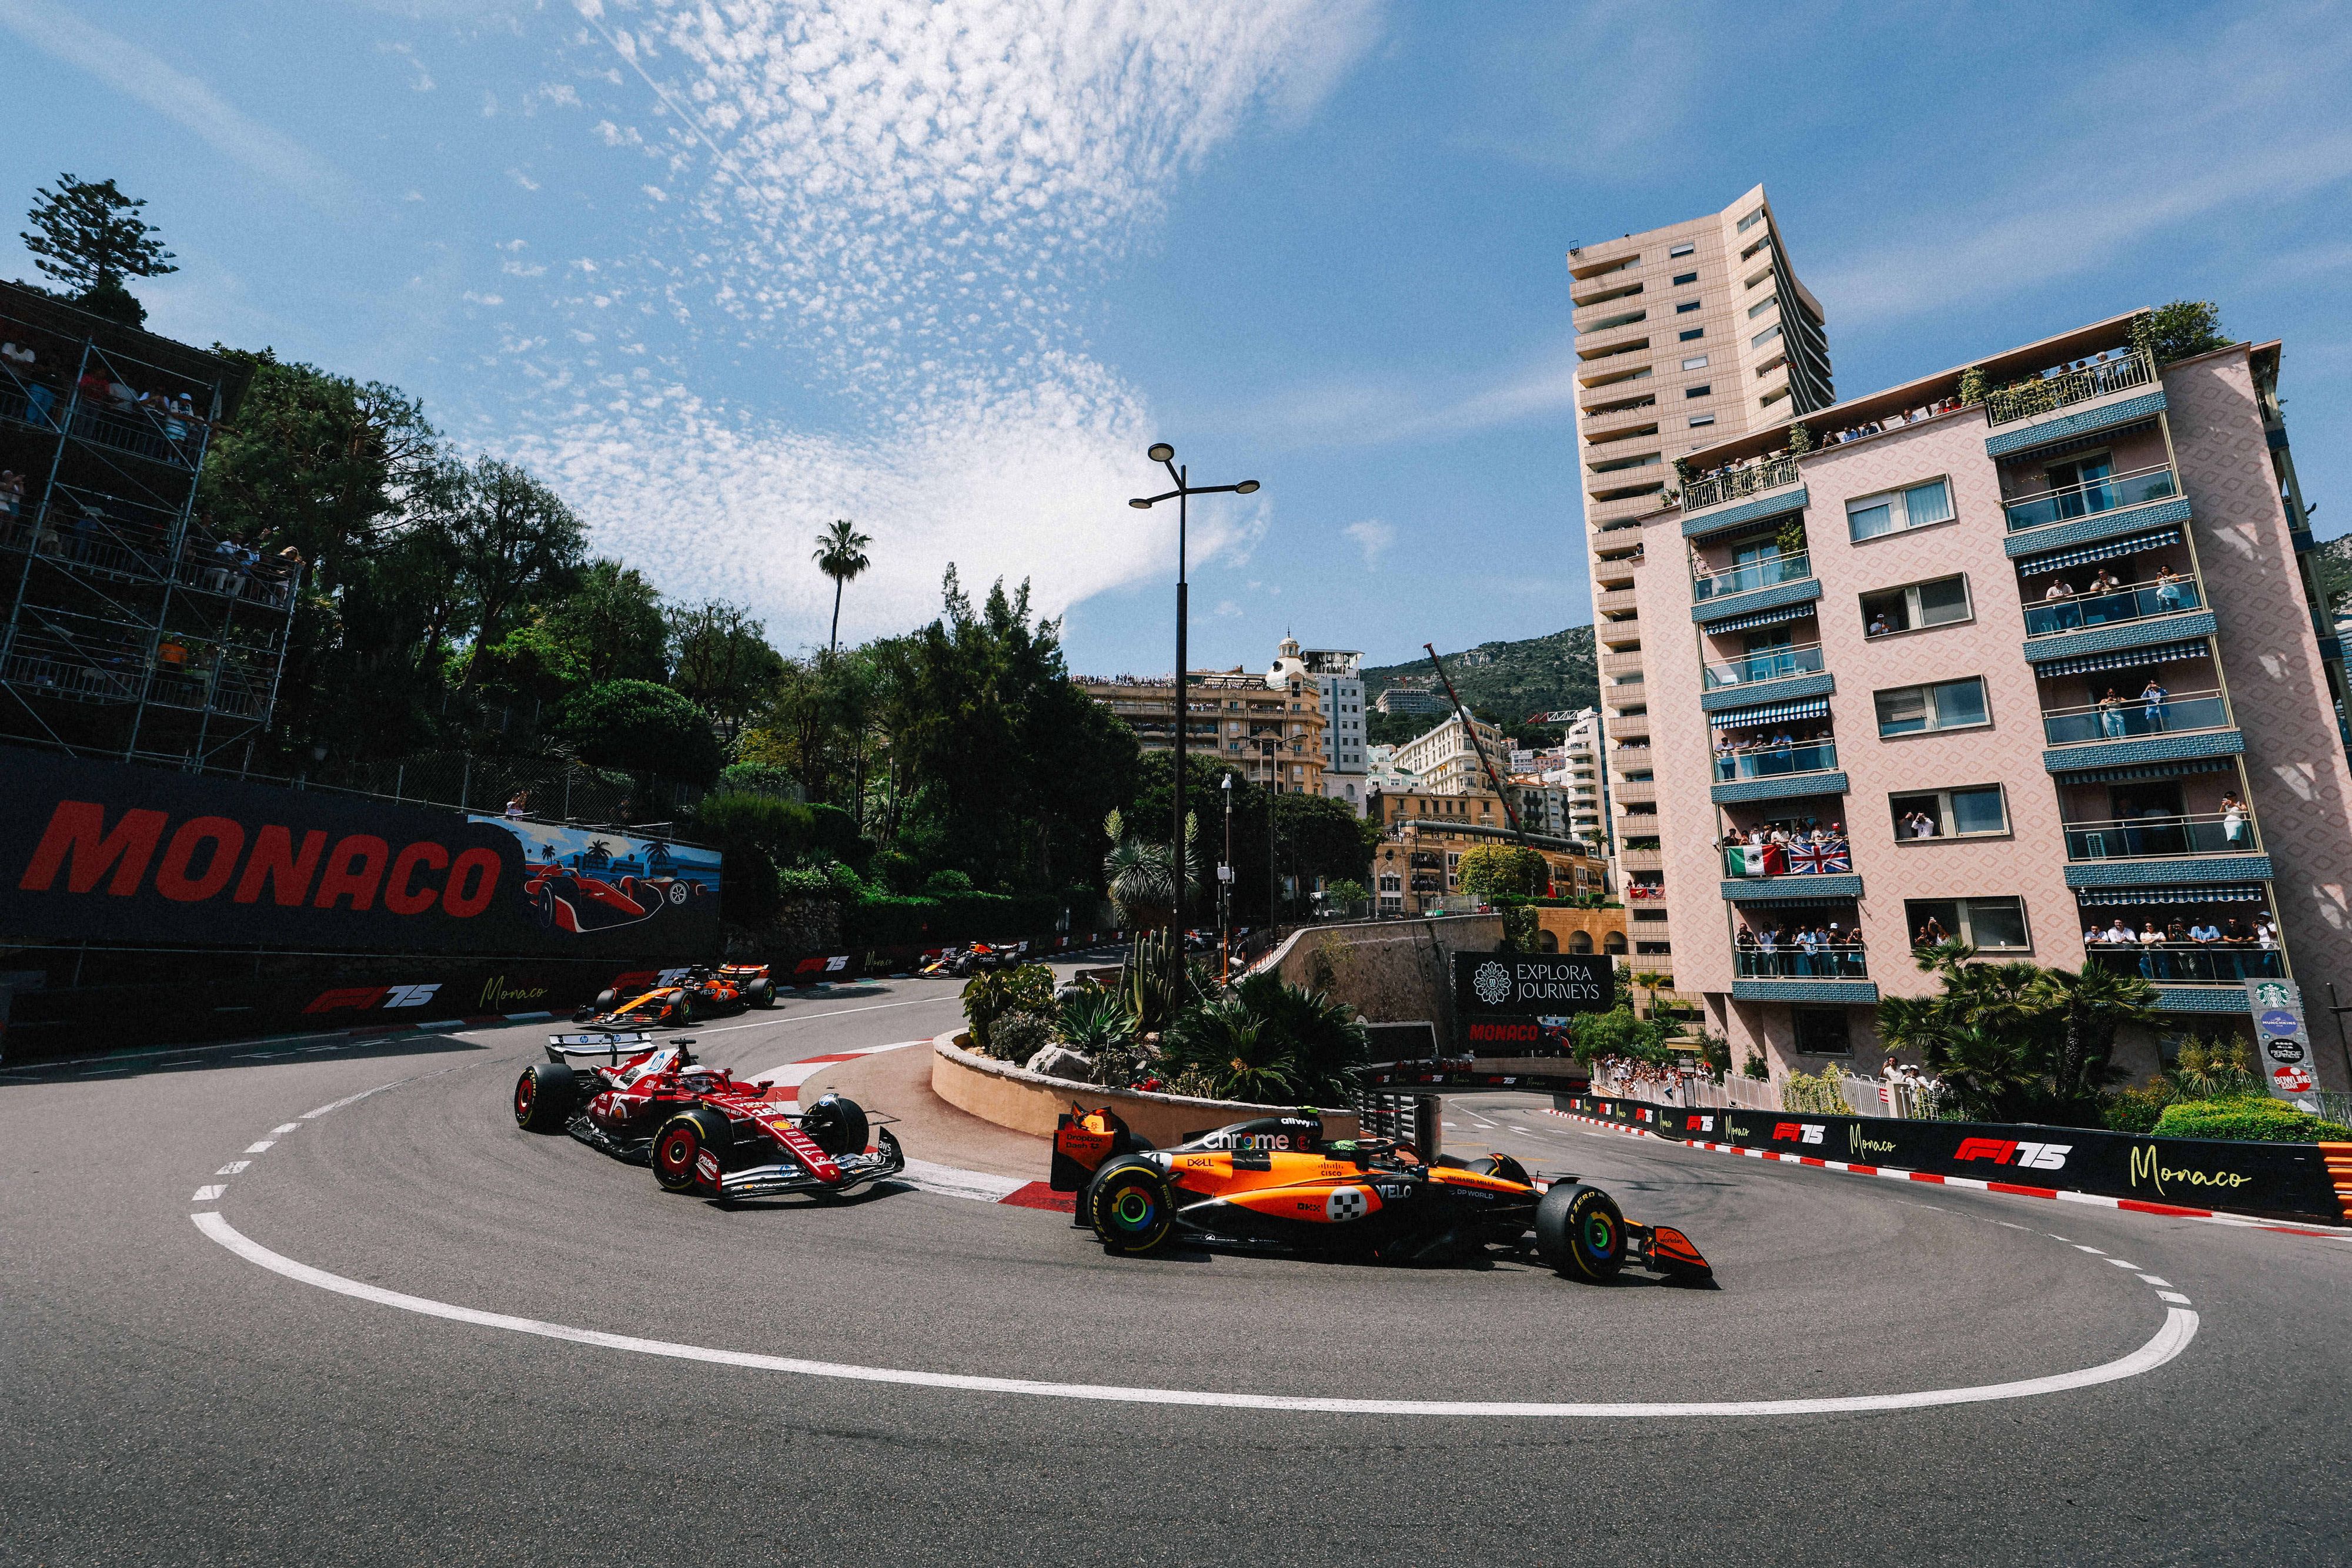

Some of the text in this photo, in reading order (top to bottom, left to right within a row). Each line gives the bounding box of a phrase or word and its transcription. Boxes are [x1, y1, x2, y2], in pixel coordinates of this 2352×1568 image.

[19, 800, 502, 918] MONACO
[825, 955, 850, 971] 75
[1517, 964, 1592, 981] EXPLORA
[302, 984, 443, 1014] F1 75
[479, 975, 547, 1010] Monaco
[1516, 983, 1599, 1002] JOURNEYS
[1469, 1025, 1538, 1041] MONACO
[2274, 1075, 2312, 1085] BOWLING
[730, 1108, 742, 1116] MILLE
[751, 1108, 779, 1116] 16
[1635, 1108, 1653, 1123] F1 75
[1281, 1117, 1318, 1128] allwyn
[1686, 1115, 1713, 1132] F1 75
[1725, 1114, 1750, 1143] Monaco
[1067, 1134, 1103, 1142] Dropbox
[1772, 1122, 1826, 1145] F1 75
[1849, 1123, 1896, 1160] Monaco
[878, 1140, 892, 1152] aws
[1953, 1137, 2073, 1170] F1 75
[1187, 1158, 1214, 1167] DELL
[2130, 1144, 2252, 1196] Monaco
[1448, 1175, 1475, 1183] RICHARD
[1375, 1185, 1412, 1199] VELO
[1468, 1190, 1494, 1199] WORLD
[1297, 1202, 1321, 1212] OKX
[1573, 1191, 1595, 1213] ZERO
[1093, 1195, 1105, 1233] ZERO
